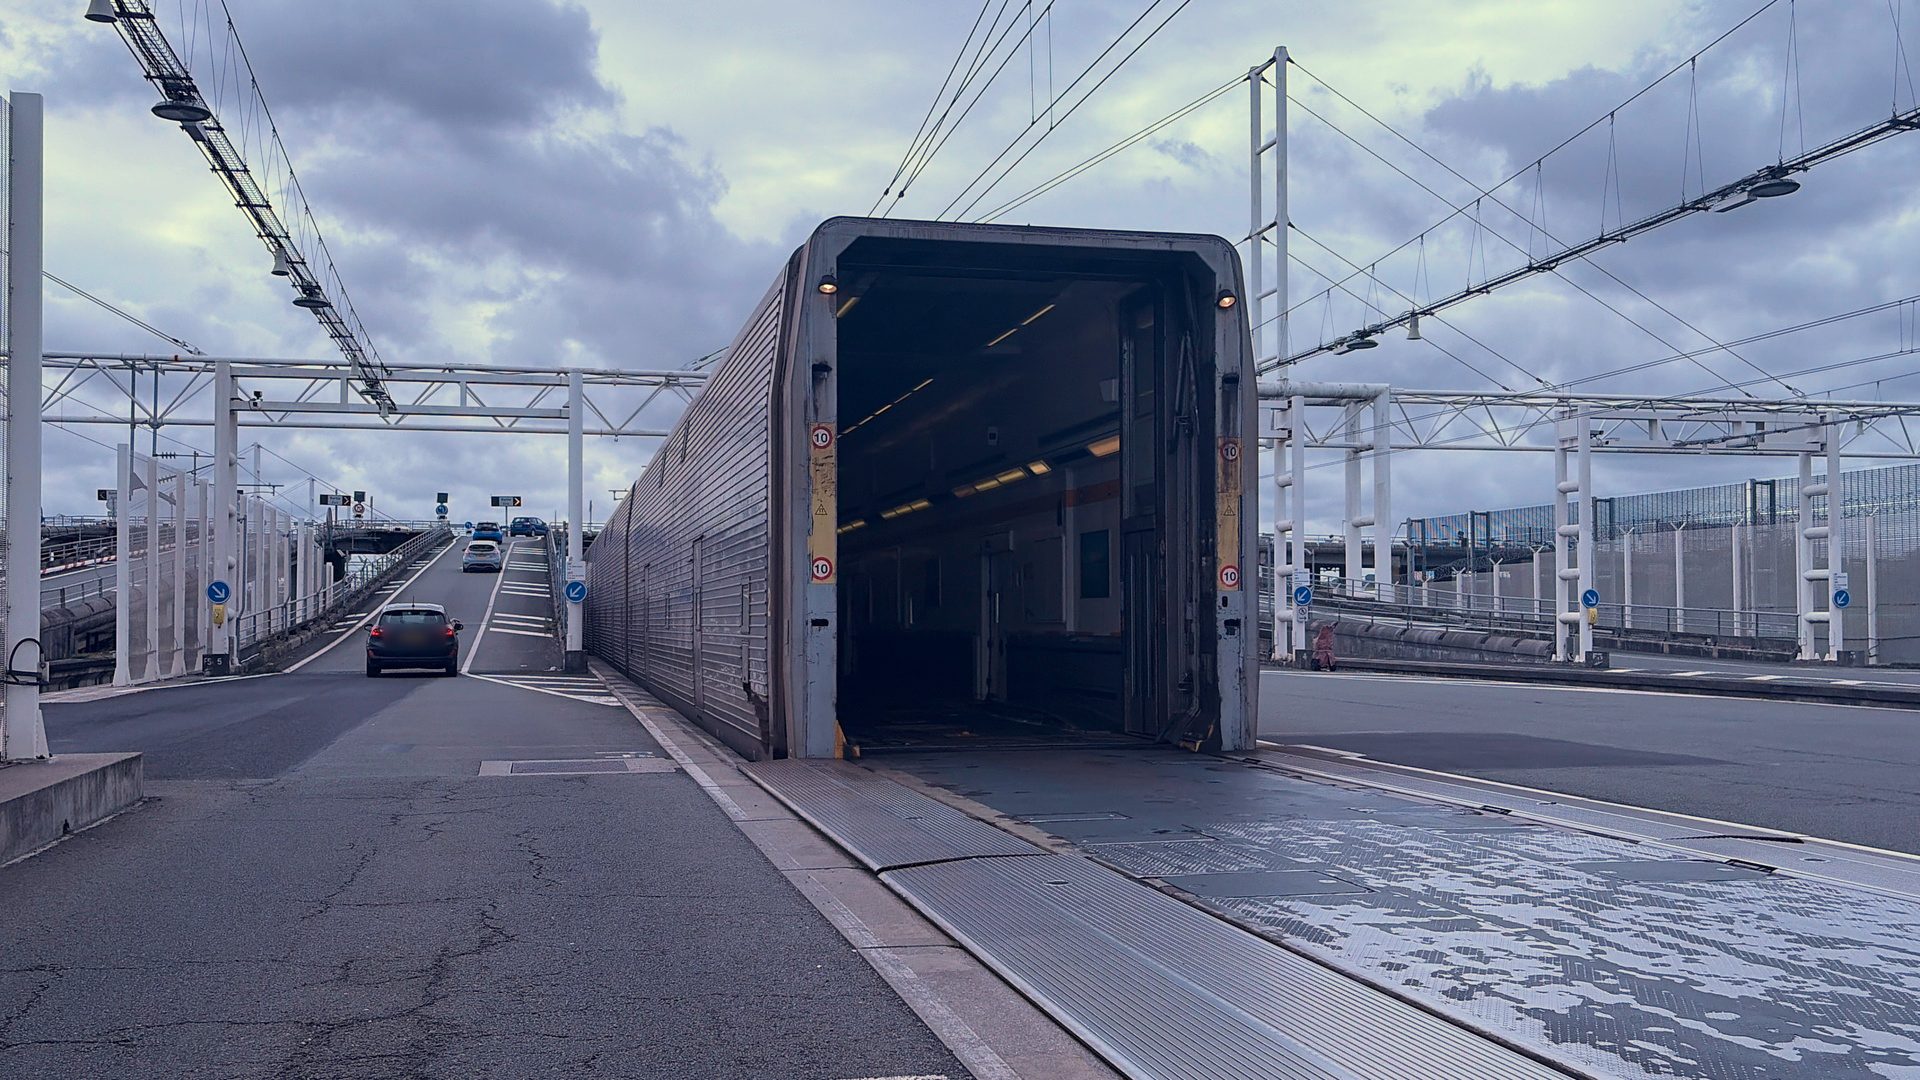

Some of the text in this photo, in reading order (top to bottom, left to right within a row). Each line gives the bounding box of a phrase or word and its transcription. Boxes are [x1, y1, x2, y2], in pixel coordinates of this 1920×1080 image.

[814, 433, 827, 442] 10
[1225, 447, 1236, 457] 10
[814, 564, 828, 573] 10
[1224, 572, 1236, 582] 10
